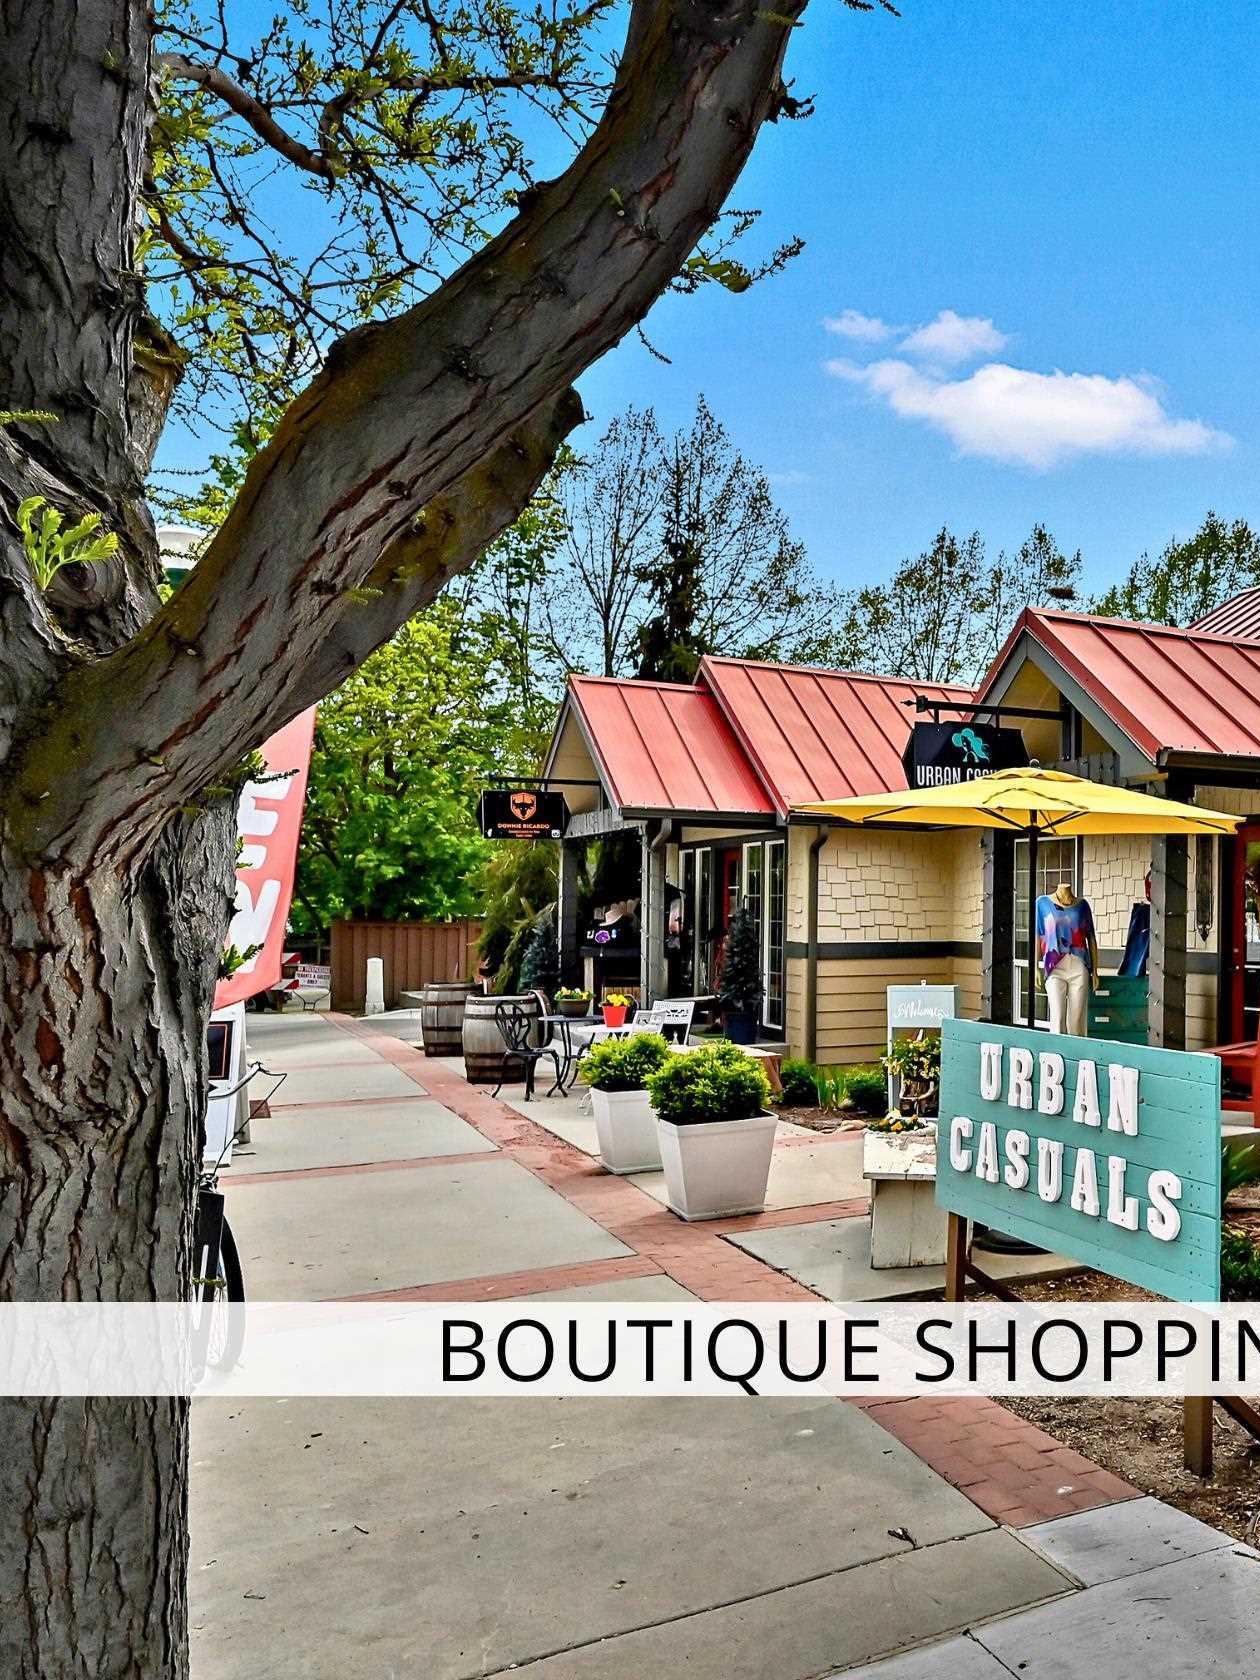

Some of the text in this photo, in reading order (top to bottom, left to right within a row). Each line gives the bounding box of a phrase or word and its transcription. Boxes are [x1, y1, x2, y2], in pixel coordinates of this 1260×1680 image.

[916, 765, 961, 787] URBAN
[980, 1042, 1140, 1137] URBAN
[949, 1116, 1183, 1242] CASUALS
